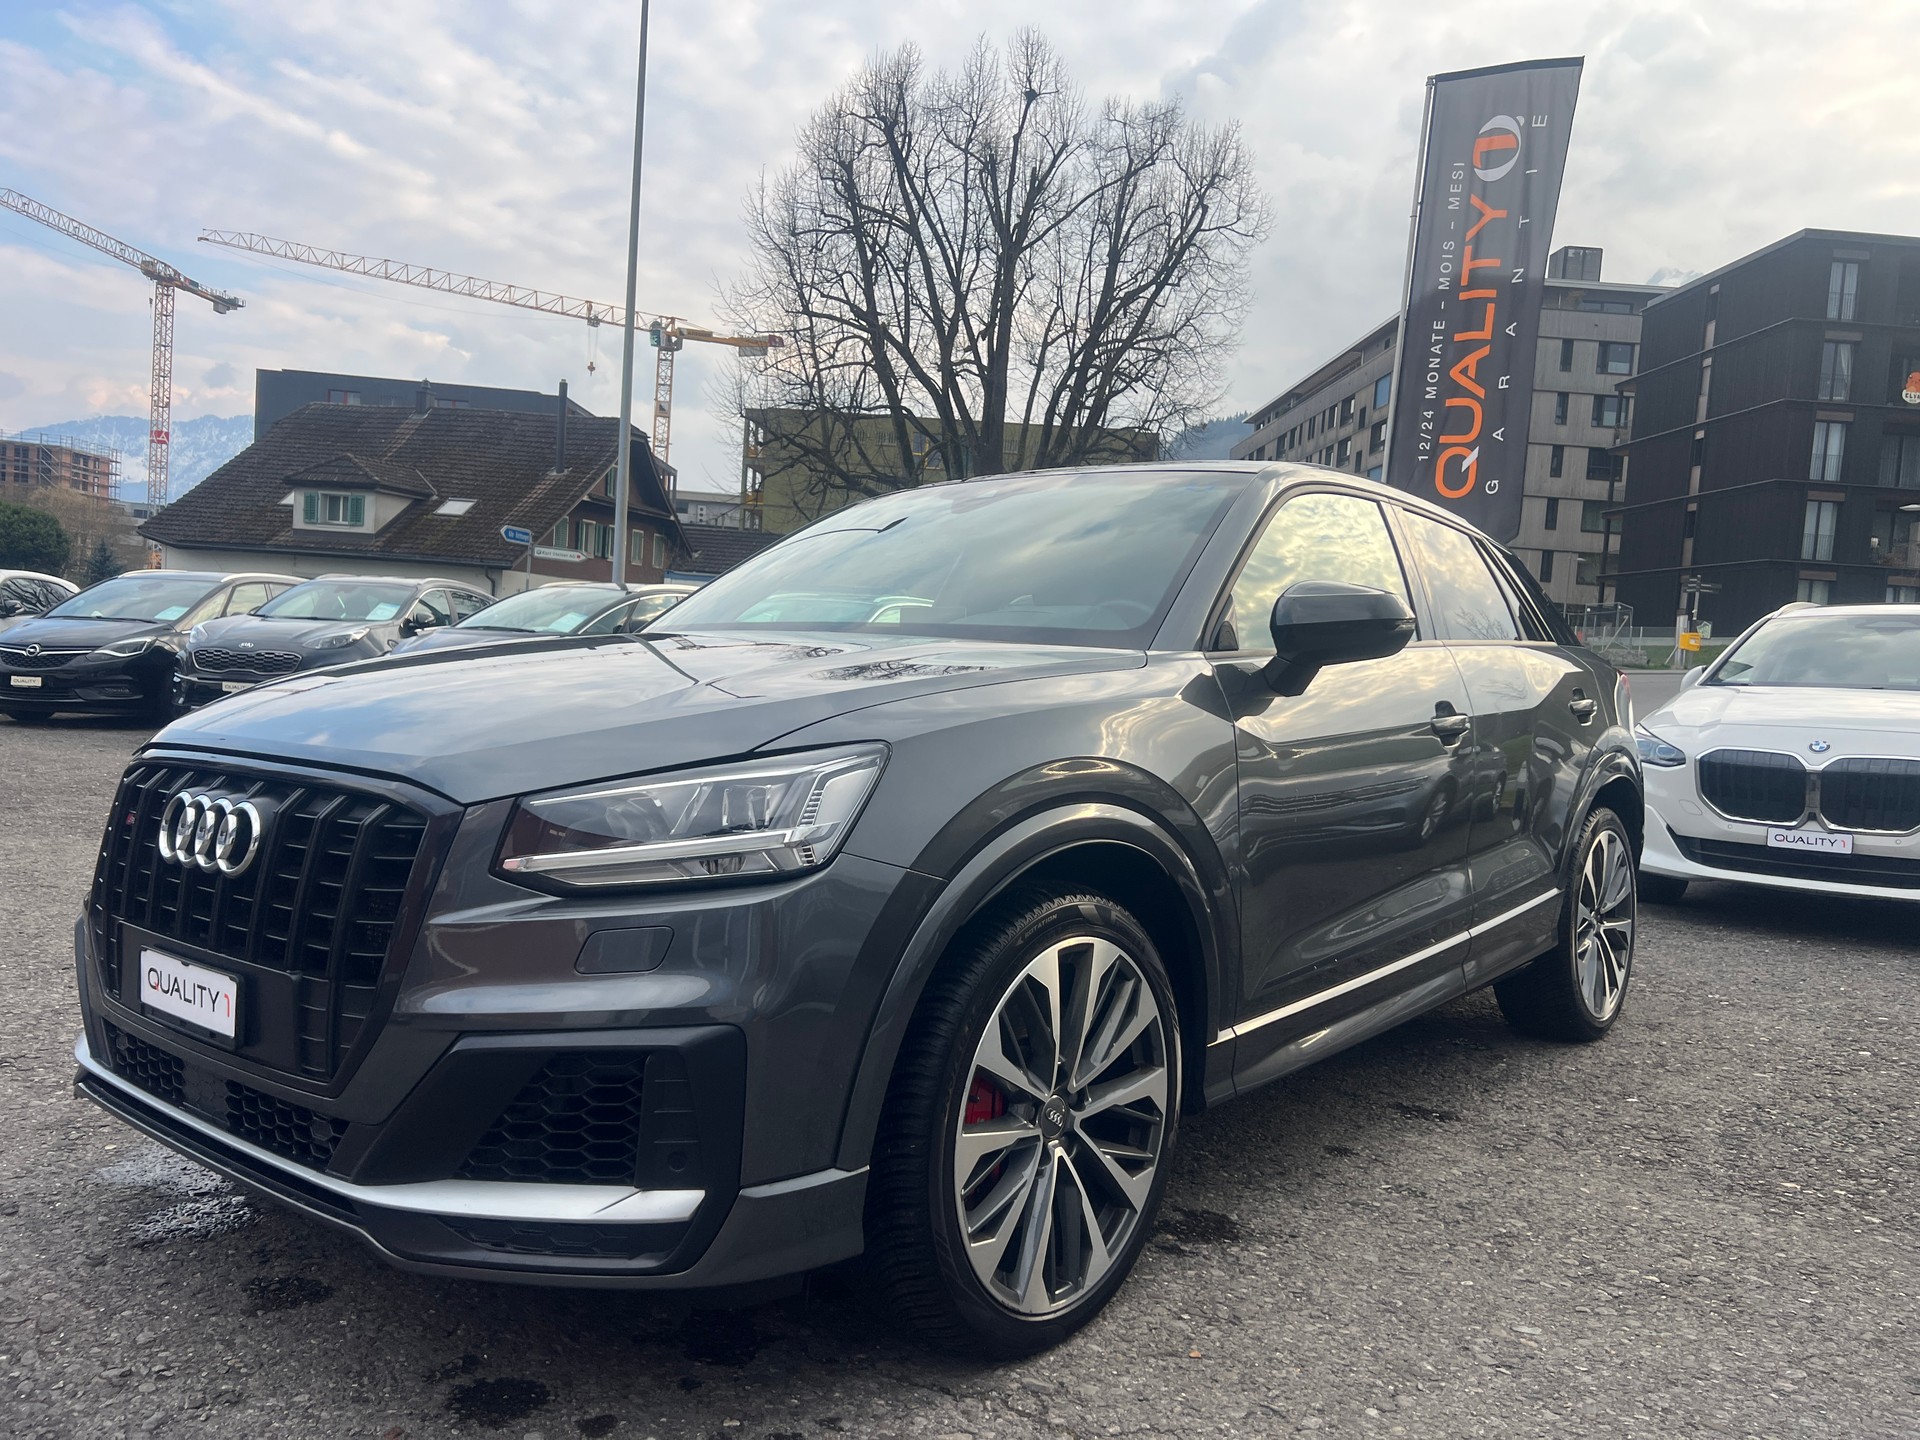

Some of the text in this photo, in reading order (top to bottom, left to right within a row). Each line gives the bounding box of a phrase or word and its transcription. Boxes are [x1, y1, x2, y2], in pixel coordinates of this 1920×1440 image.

[1448, 162, 1465, 210] MESI
[1438, 241, 1455, 290] MOIS
[1425, 320, 1445, 399] MONATE
[1435, 193, 1508, 499] QUALITY
[1418, 410, 1434, 461] 12/24
[1774, 833, 1847, 848] QUALITY 1
[1024, 913, 1058, 939] ROTATION
[147, 967, 231, 1018] QUALITY 1
